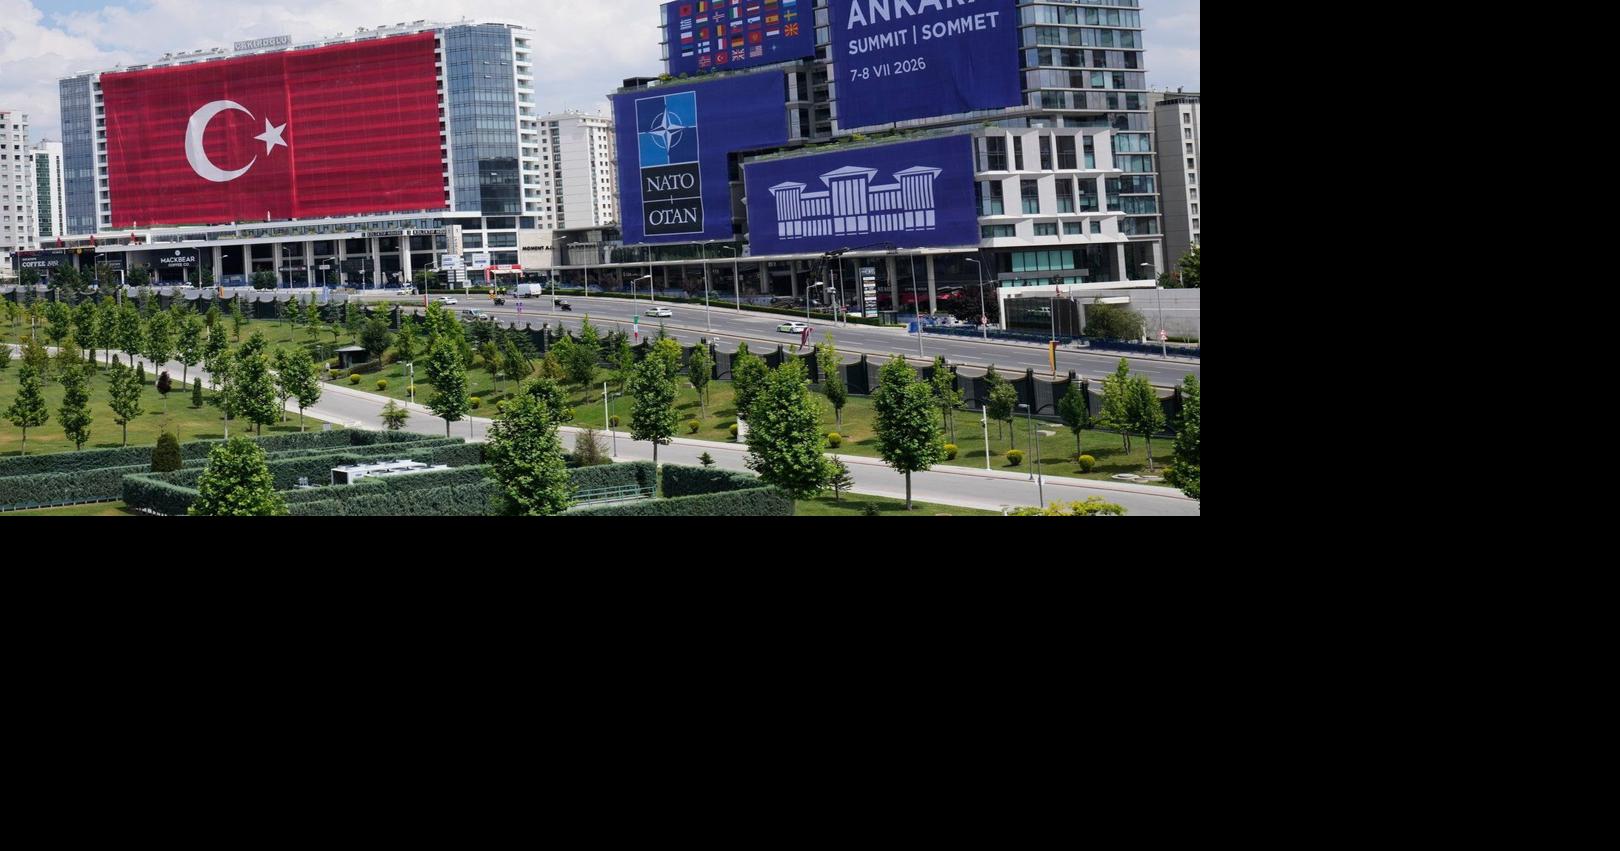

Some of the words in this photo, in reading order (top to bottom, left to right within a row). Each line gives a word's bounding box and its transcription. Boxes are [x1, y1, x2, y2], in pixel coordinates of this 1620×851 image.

[849, 29, 907, 54] SUMMIT
[922, 12, 999, 40] SOMMET
[850, 67, 870, 82] 7-8
[873, 63, 890, 78] VII
[894, 57, 926, 75] 2026
[646, 173, 694, 192] NATO
[649, 207, 697, 226] OTAN
